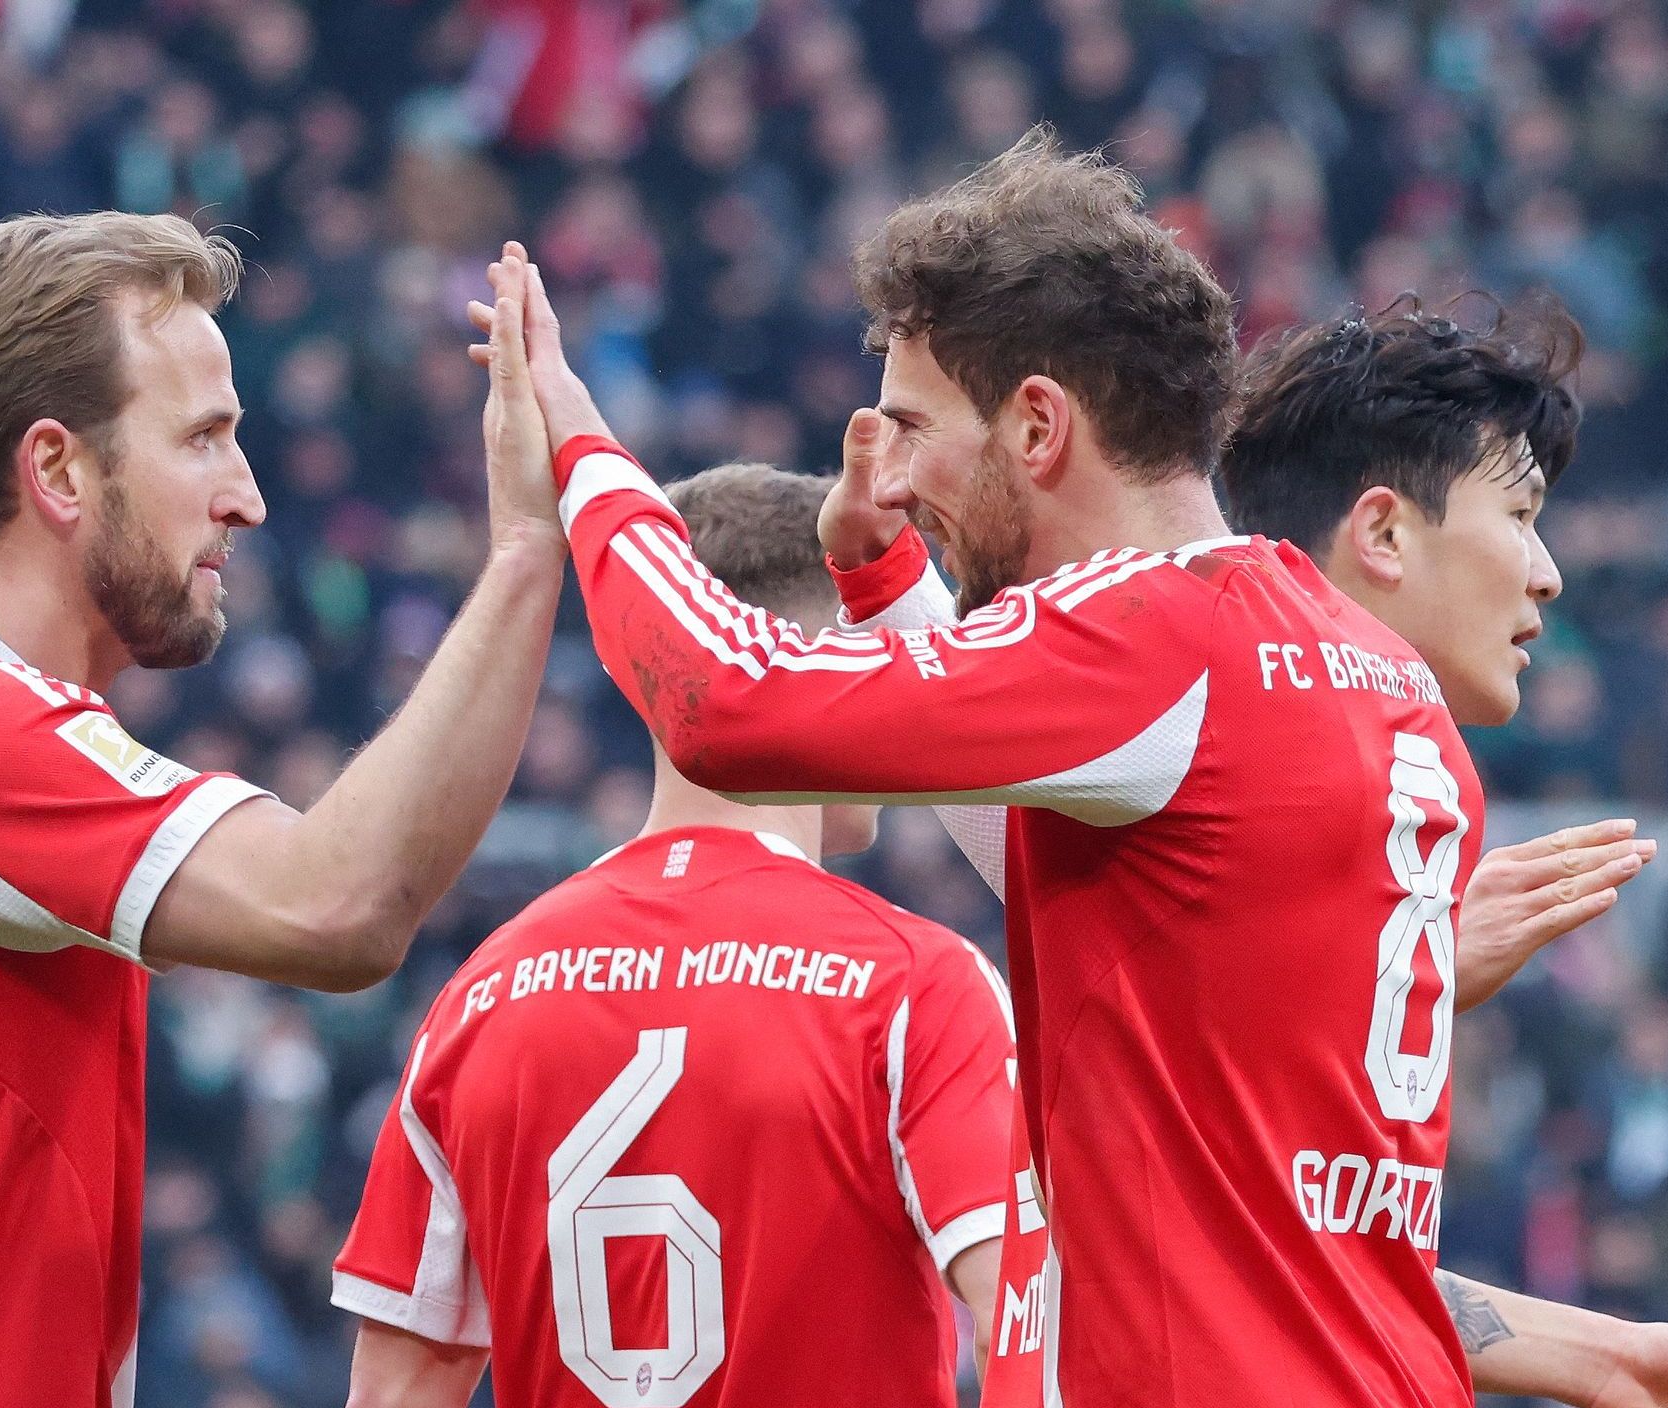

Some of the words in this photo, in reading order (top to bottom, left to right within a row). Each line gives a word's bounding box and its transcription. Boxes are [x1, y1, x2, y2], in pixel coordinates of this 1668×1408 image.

[1257, 642, 1314, 690] FC
[1364, 732, 1470, 1123] 8
[460, 971, 502, 1026] FC
[509, 945, 664, 1002] BAYERN
[675, 940, 876, 999] MÜNCHEN
